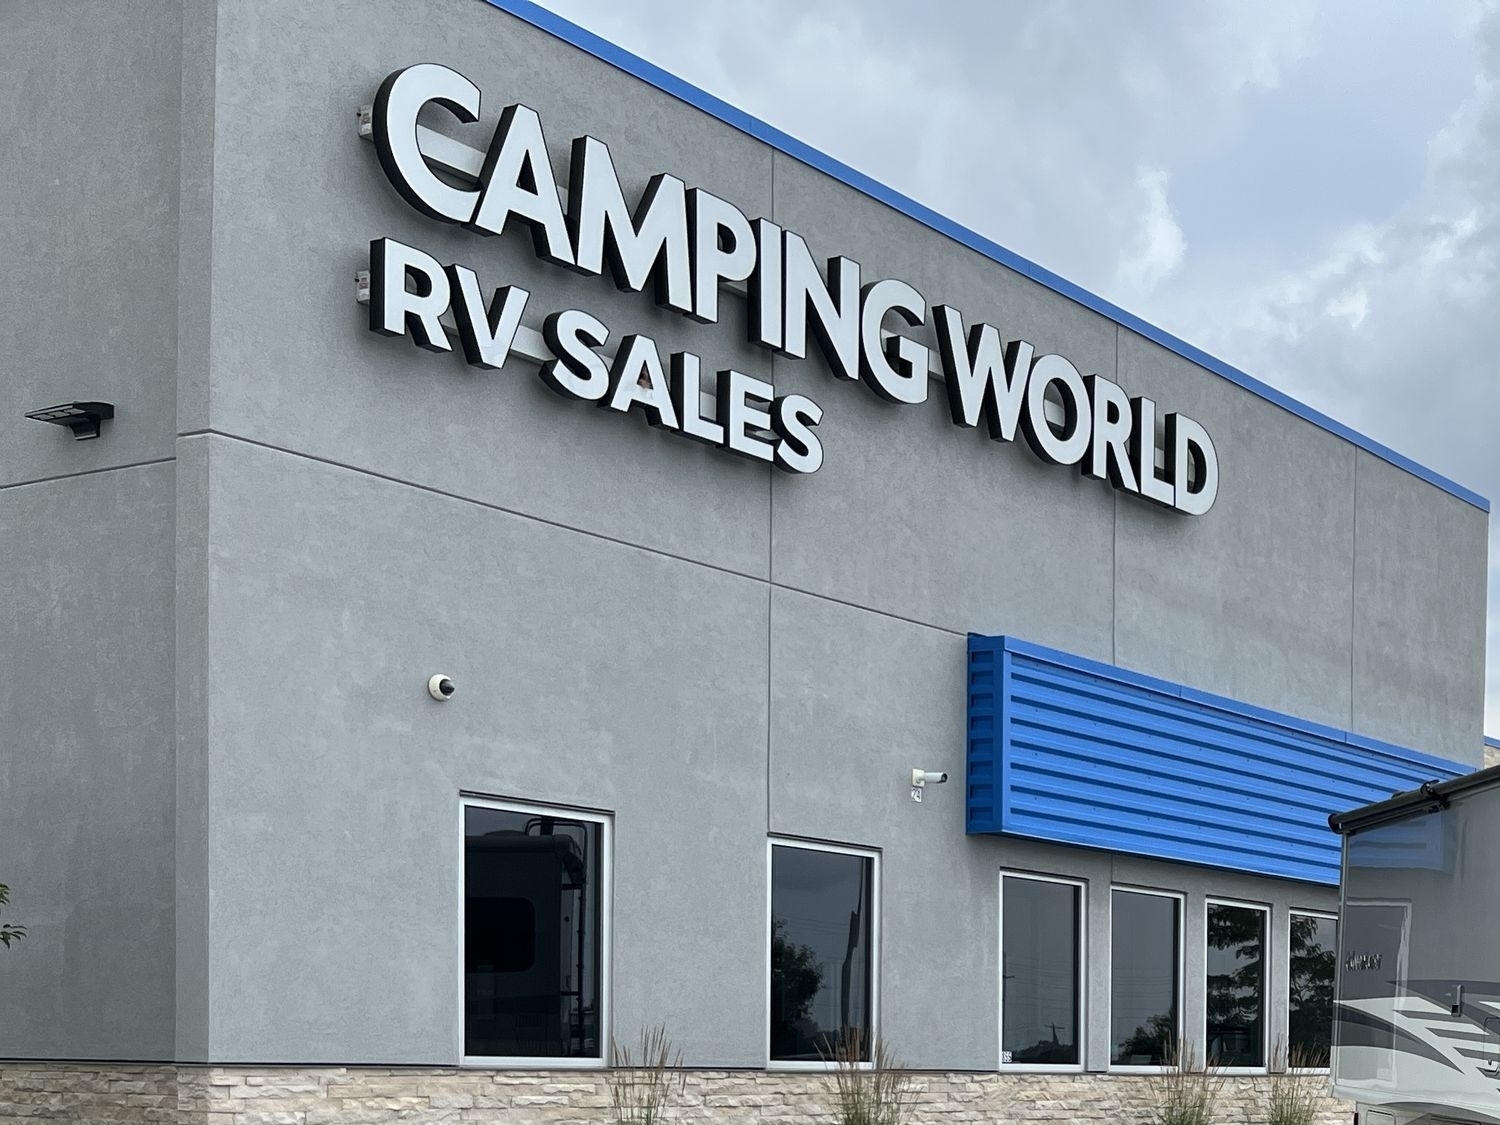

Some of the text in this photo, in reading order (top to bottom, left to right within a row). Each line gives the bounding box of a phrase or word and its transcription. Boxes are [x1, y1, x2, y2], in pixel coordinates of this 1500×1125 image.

[370, 237, 824, 474] RV SALES
[373, 63, 1219, 516] CAMPING WORLD
